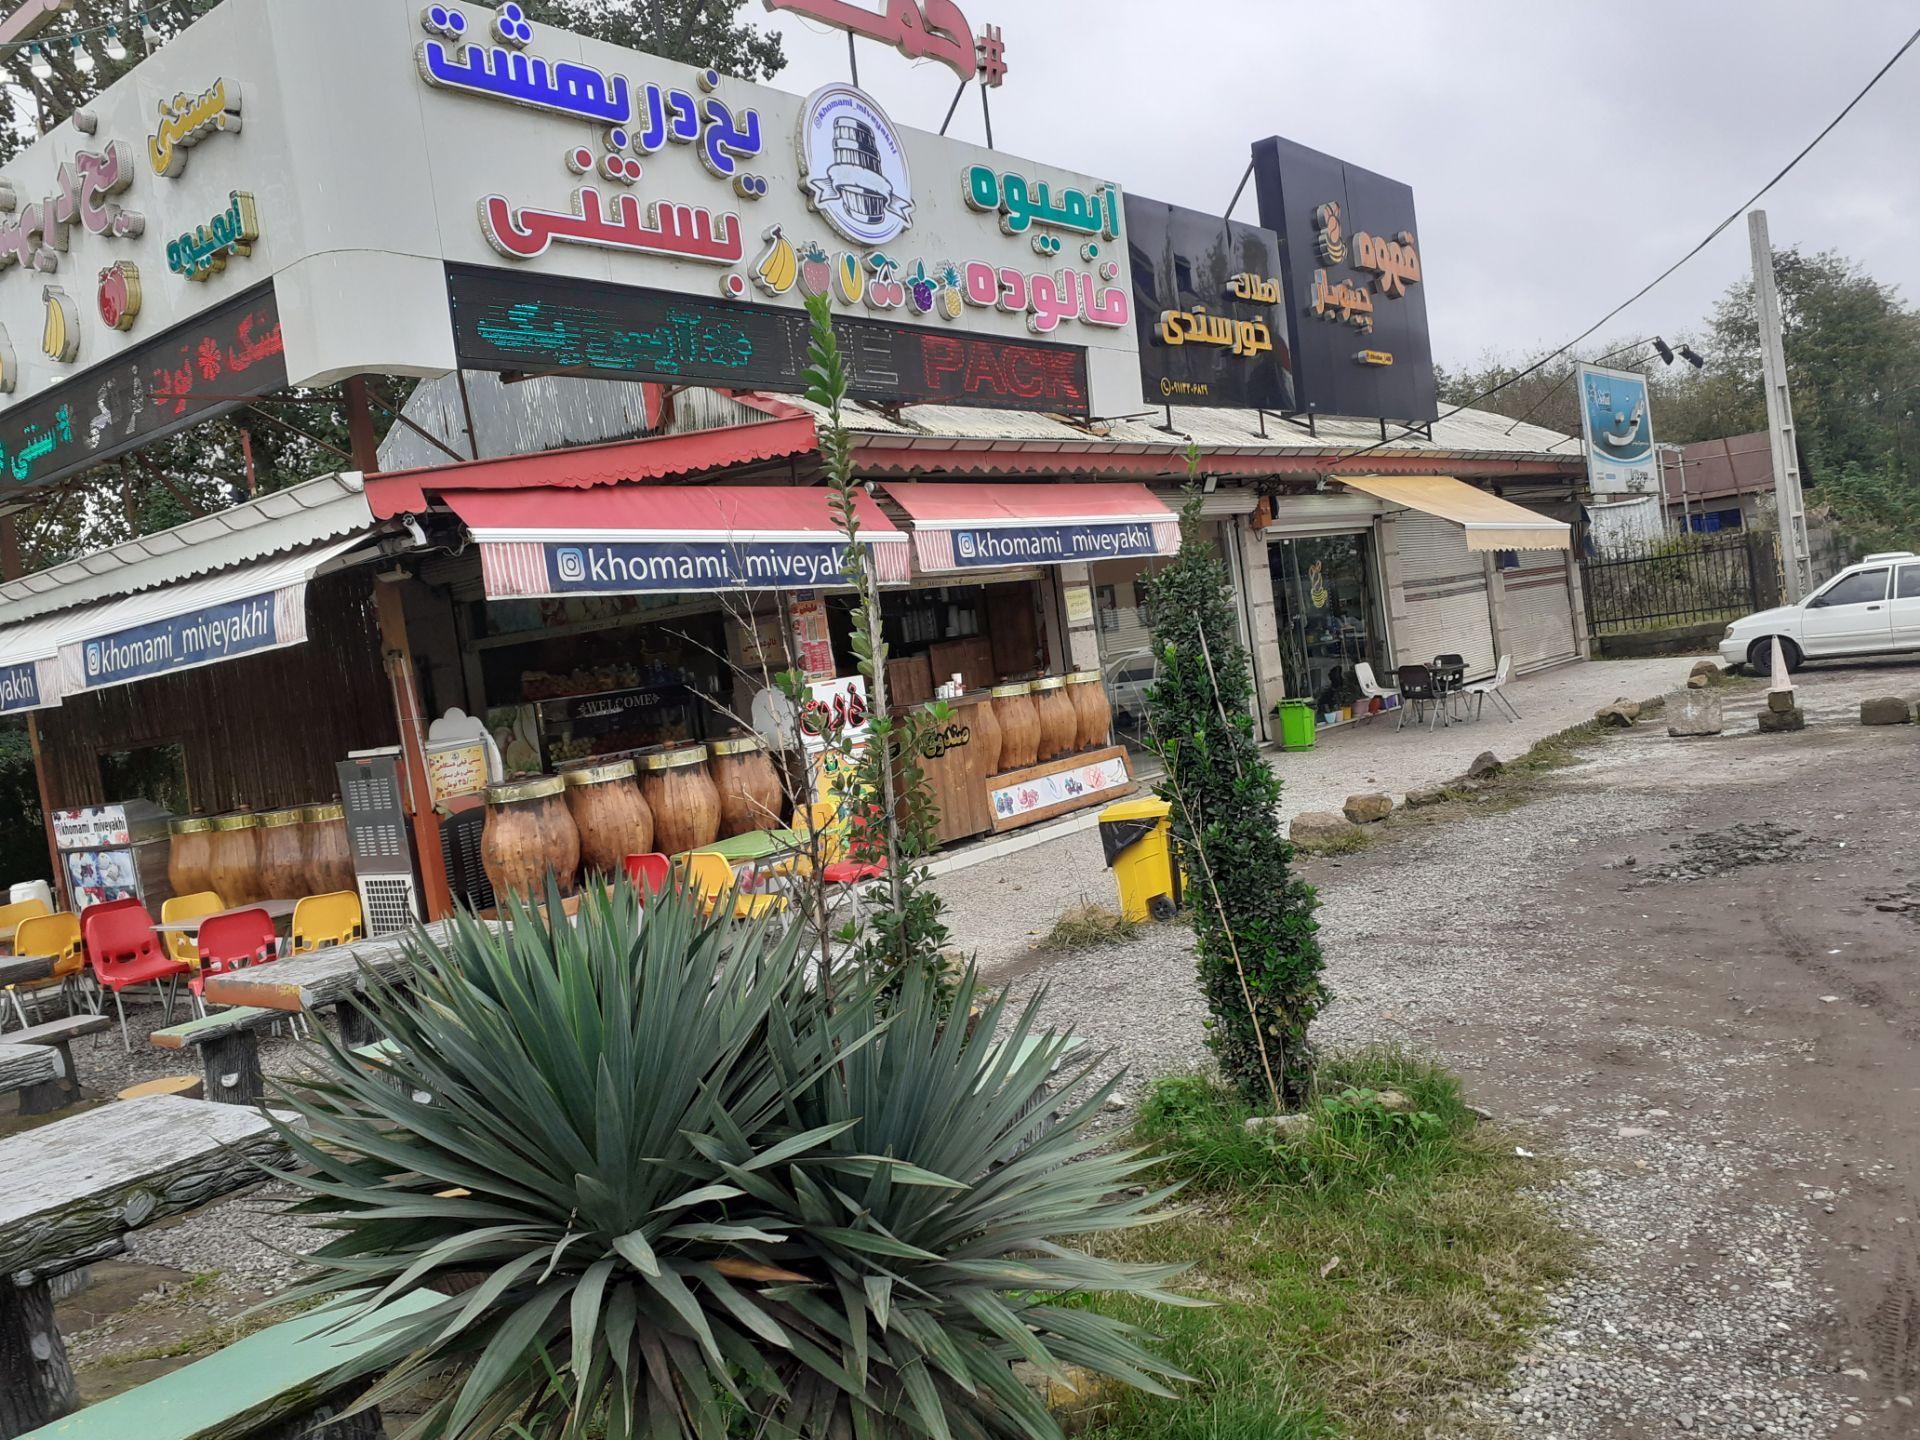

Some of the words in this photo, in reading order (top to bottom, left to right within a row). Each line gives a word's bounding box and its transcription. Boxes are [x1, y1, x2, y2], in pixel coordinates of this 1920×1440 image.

[415, 1, 631, 153] بهشت
[147, 77, 242, 179] بستنی
[477, 145, 746, 298] بستنی
[960, 258, 1129, 333] فالوده
[1353, 231, 1420, 300] قهوه
[921, 334, 1081, 400] PACK
[1155, 305, 1272, 357] خورسندی
[976, 526, 1151, 557] khomami_miveyakhi
[101, 599, 269, 675] khomami_miveyakhi
[587, 693, 653, 714] WELCOME
